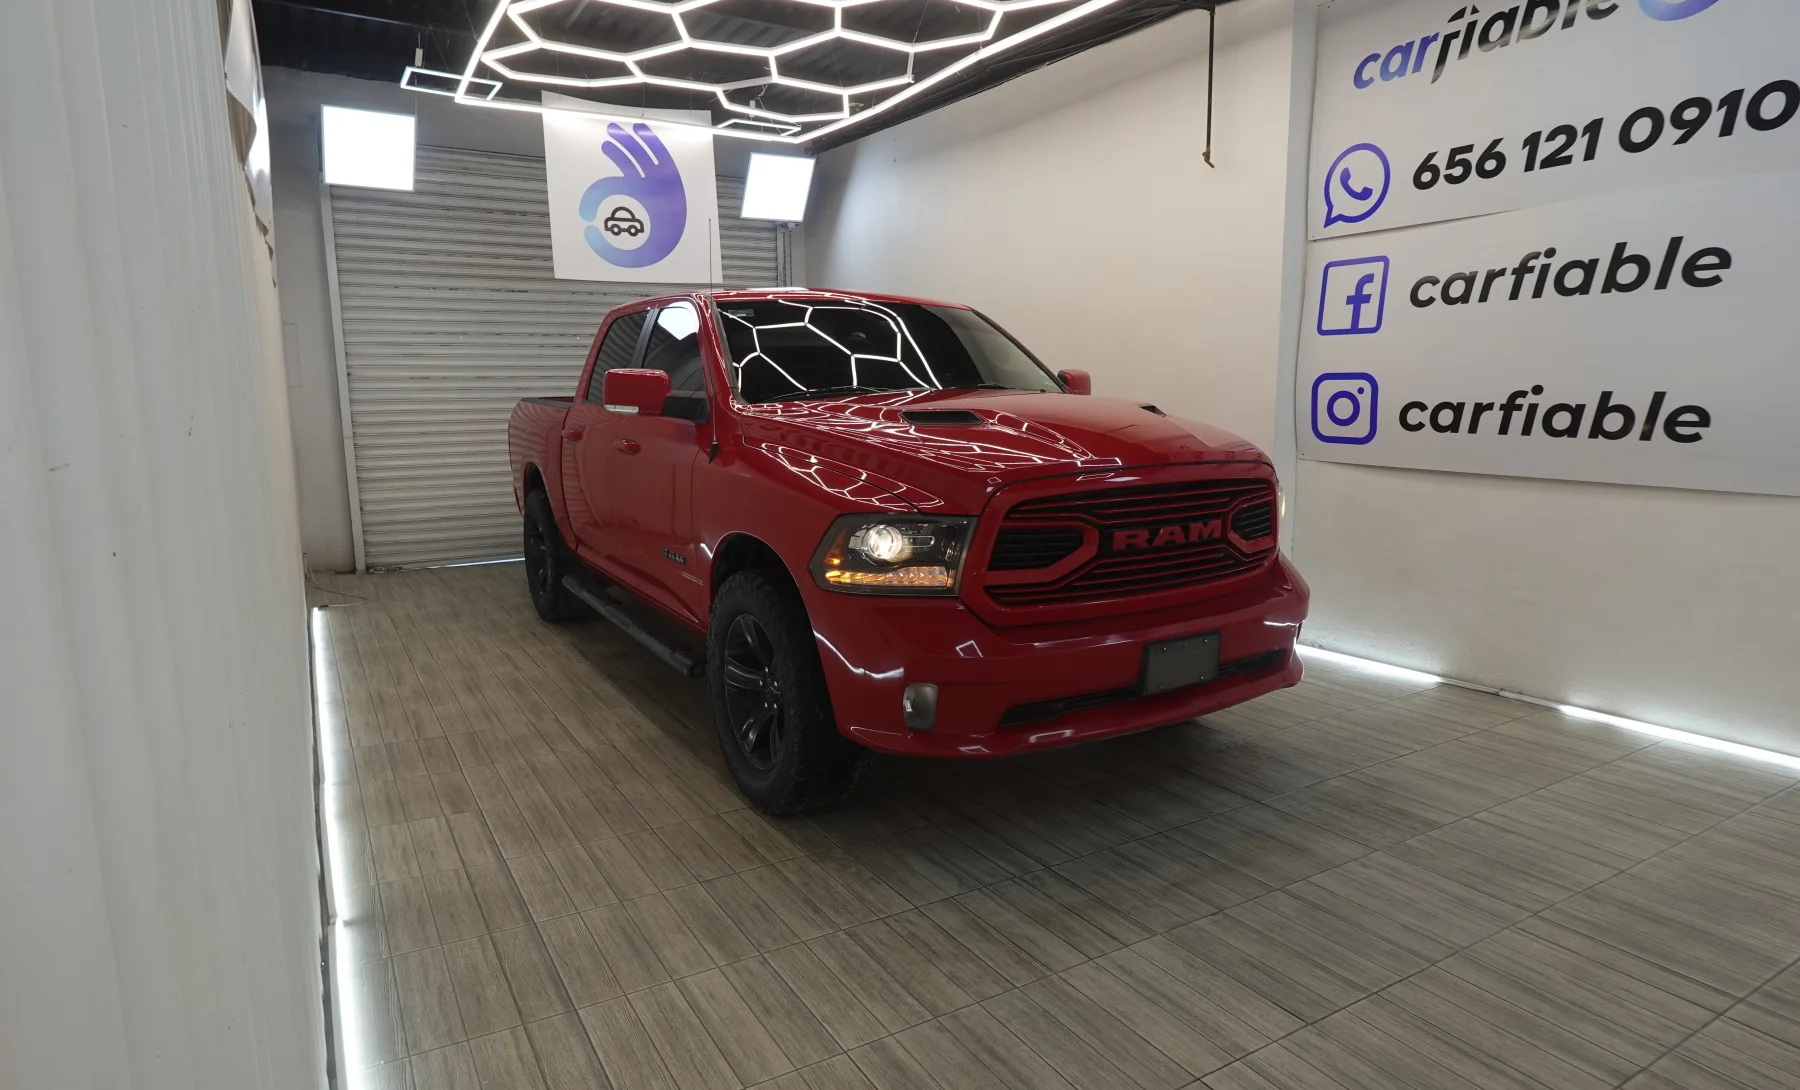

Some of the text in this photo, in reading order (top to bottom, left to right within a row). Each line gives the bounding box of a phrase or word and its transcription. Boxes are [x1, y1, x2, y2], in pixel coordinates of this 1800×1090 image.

[1412, 79, 1800, 190] 656 121 0910
[1409, 235, 1732, 309] carfiable
[1398, 384, 1712, 444] carfiable
[1112, 519, 1222, 552] RAM
